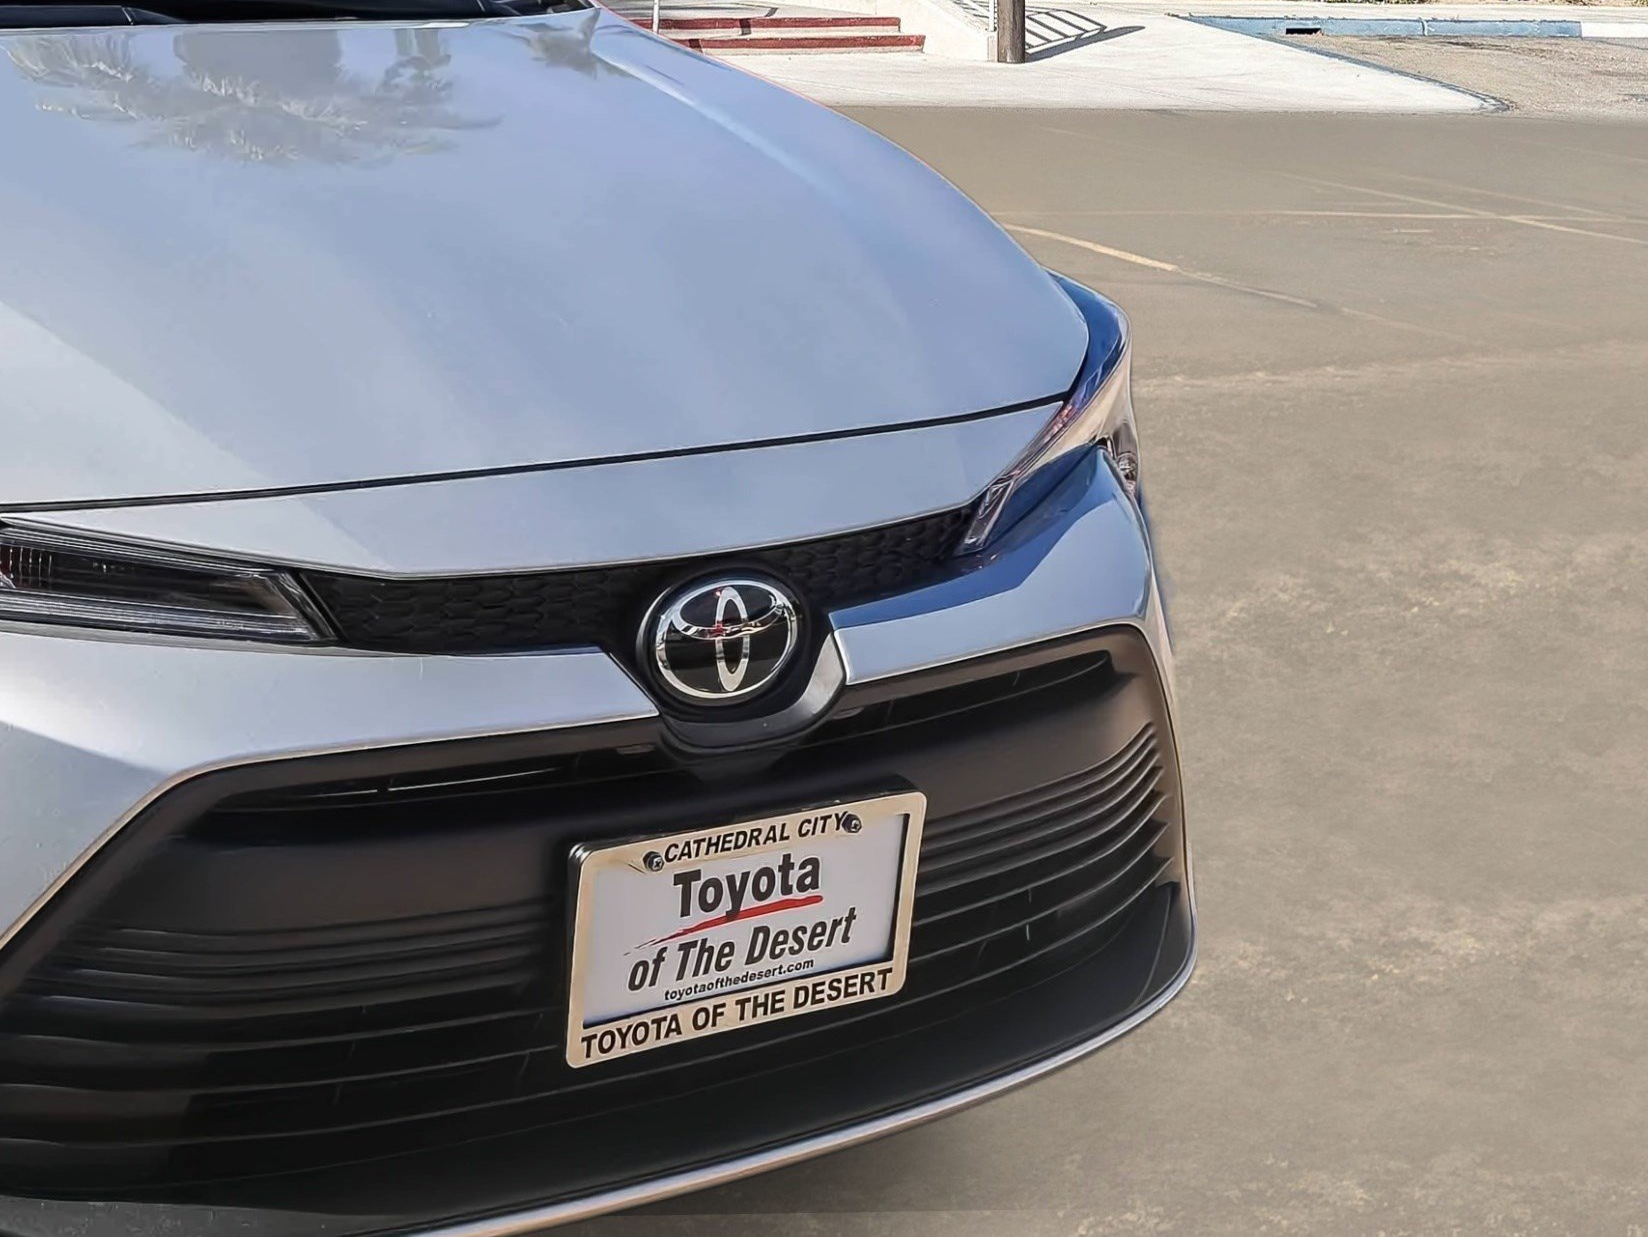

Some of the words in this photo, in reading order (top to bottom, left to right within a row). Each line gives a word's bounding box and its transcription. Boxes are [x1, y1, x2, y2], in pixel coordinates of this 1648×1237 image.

[664, 822, 791, 863] CATHEDRAL
[798, 811, 848, 838] CITY
[673, 853, 820, 921] Toyota
[628, 947, 668, 992] of
[675, 938, 735, 981] The
[745, 907, 857, 966] Desert
[664, 959, 814, 1001] toyotaofthedesert.com
[581, 1013, 682, 1058] TOYOTA
[692, 1003, 726, 1031] OF
[735, 989, 786, 1021] THE
[793, 967, 893, 1009] DESERT
